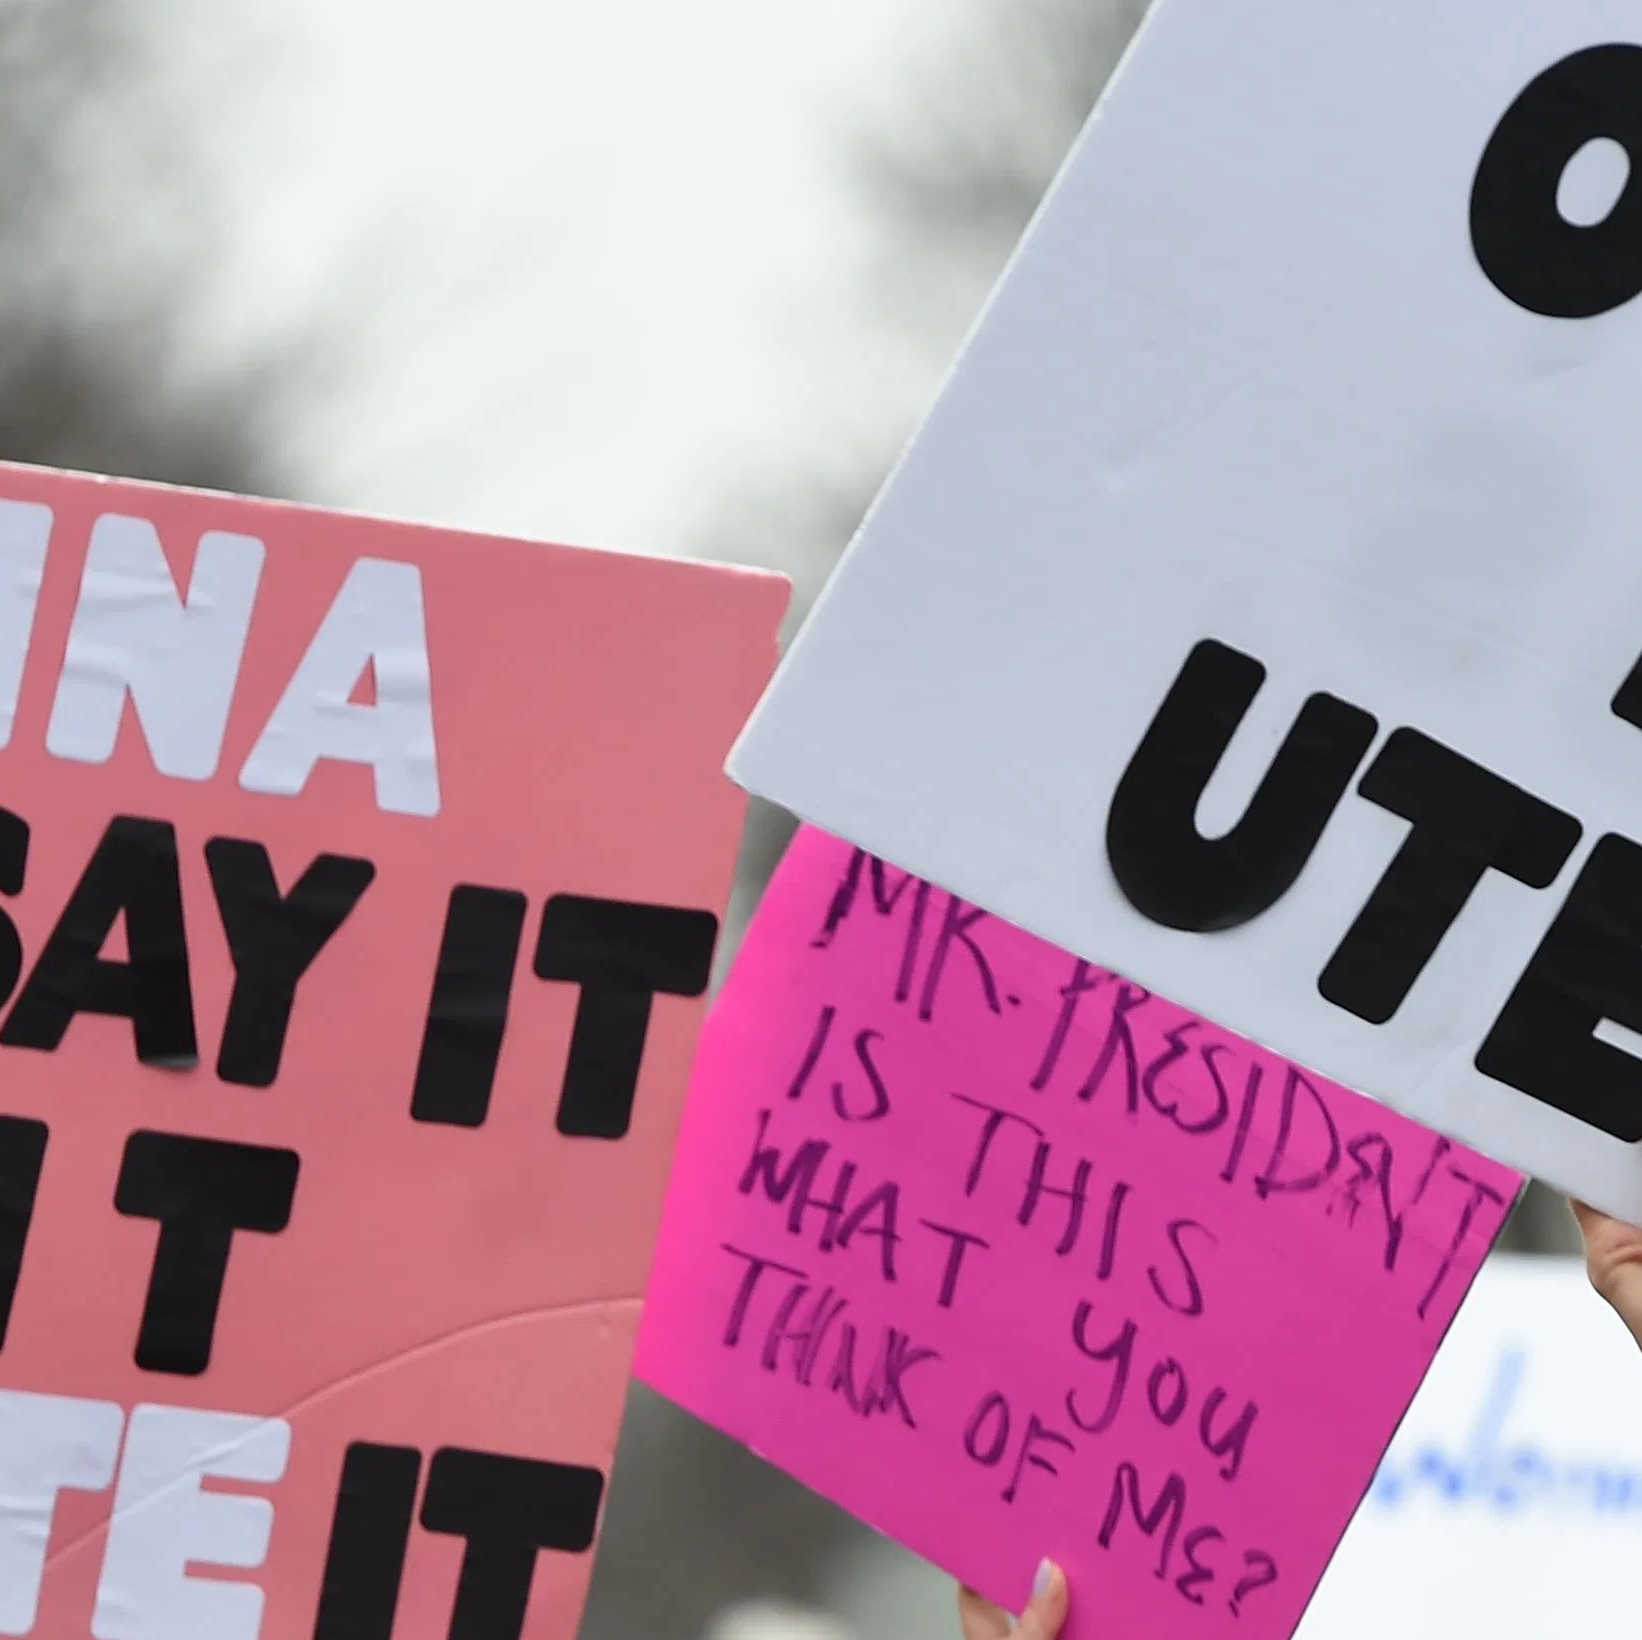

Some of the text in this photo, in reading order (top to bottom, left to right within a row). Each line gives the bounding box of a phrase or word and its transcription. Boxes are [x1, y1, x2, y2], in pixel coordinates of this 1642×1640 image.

[411, 886, 717, 1138] IT
[740, 1110, 990, 1309] WHAT
[788, 1006, 1221, 1317] IS THIS
[721, 1244, 1278, 1618] THINK OF ME?
